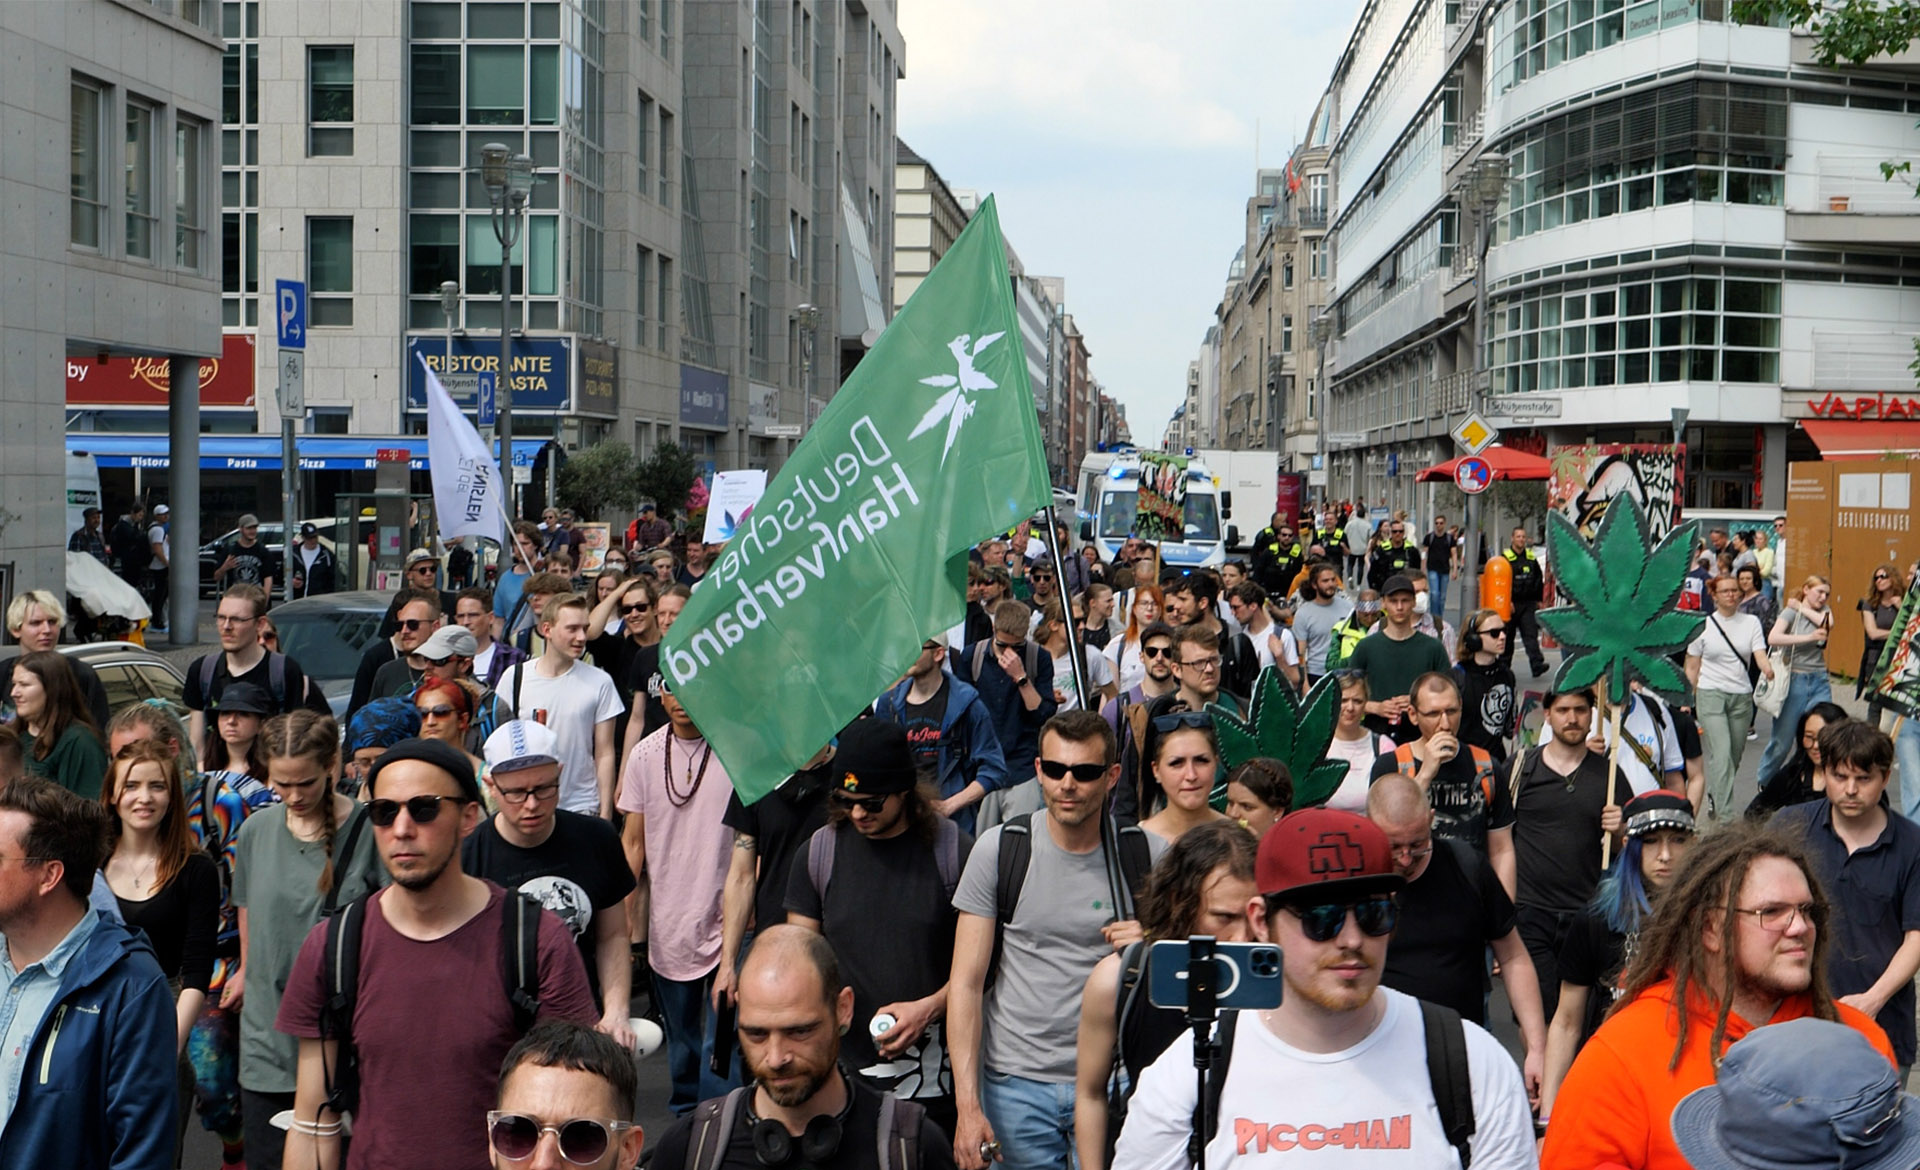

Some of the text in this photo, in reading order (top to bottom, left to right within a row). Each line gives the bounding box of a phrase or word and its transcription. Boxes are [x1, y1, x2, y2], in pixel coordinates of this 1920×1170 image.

[1630, 7, 1689, 31] Deutsche Leasing
[280, 288, 298, 339] P
[426, 355, 552, 373] RISTORNTE
[481, 378, 491, 418] P
[1491, 401, 1554, 412] Schützenstraße
[227, 458, 257, 468] Pasta
[1443, 782, 1469, 806] THE
